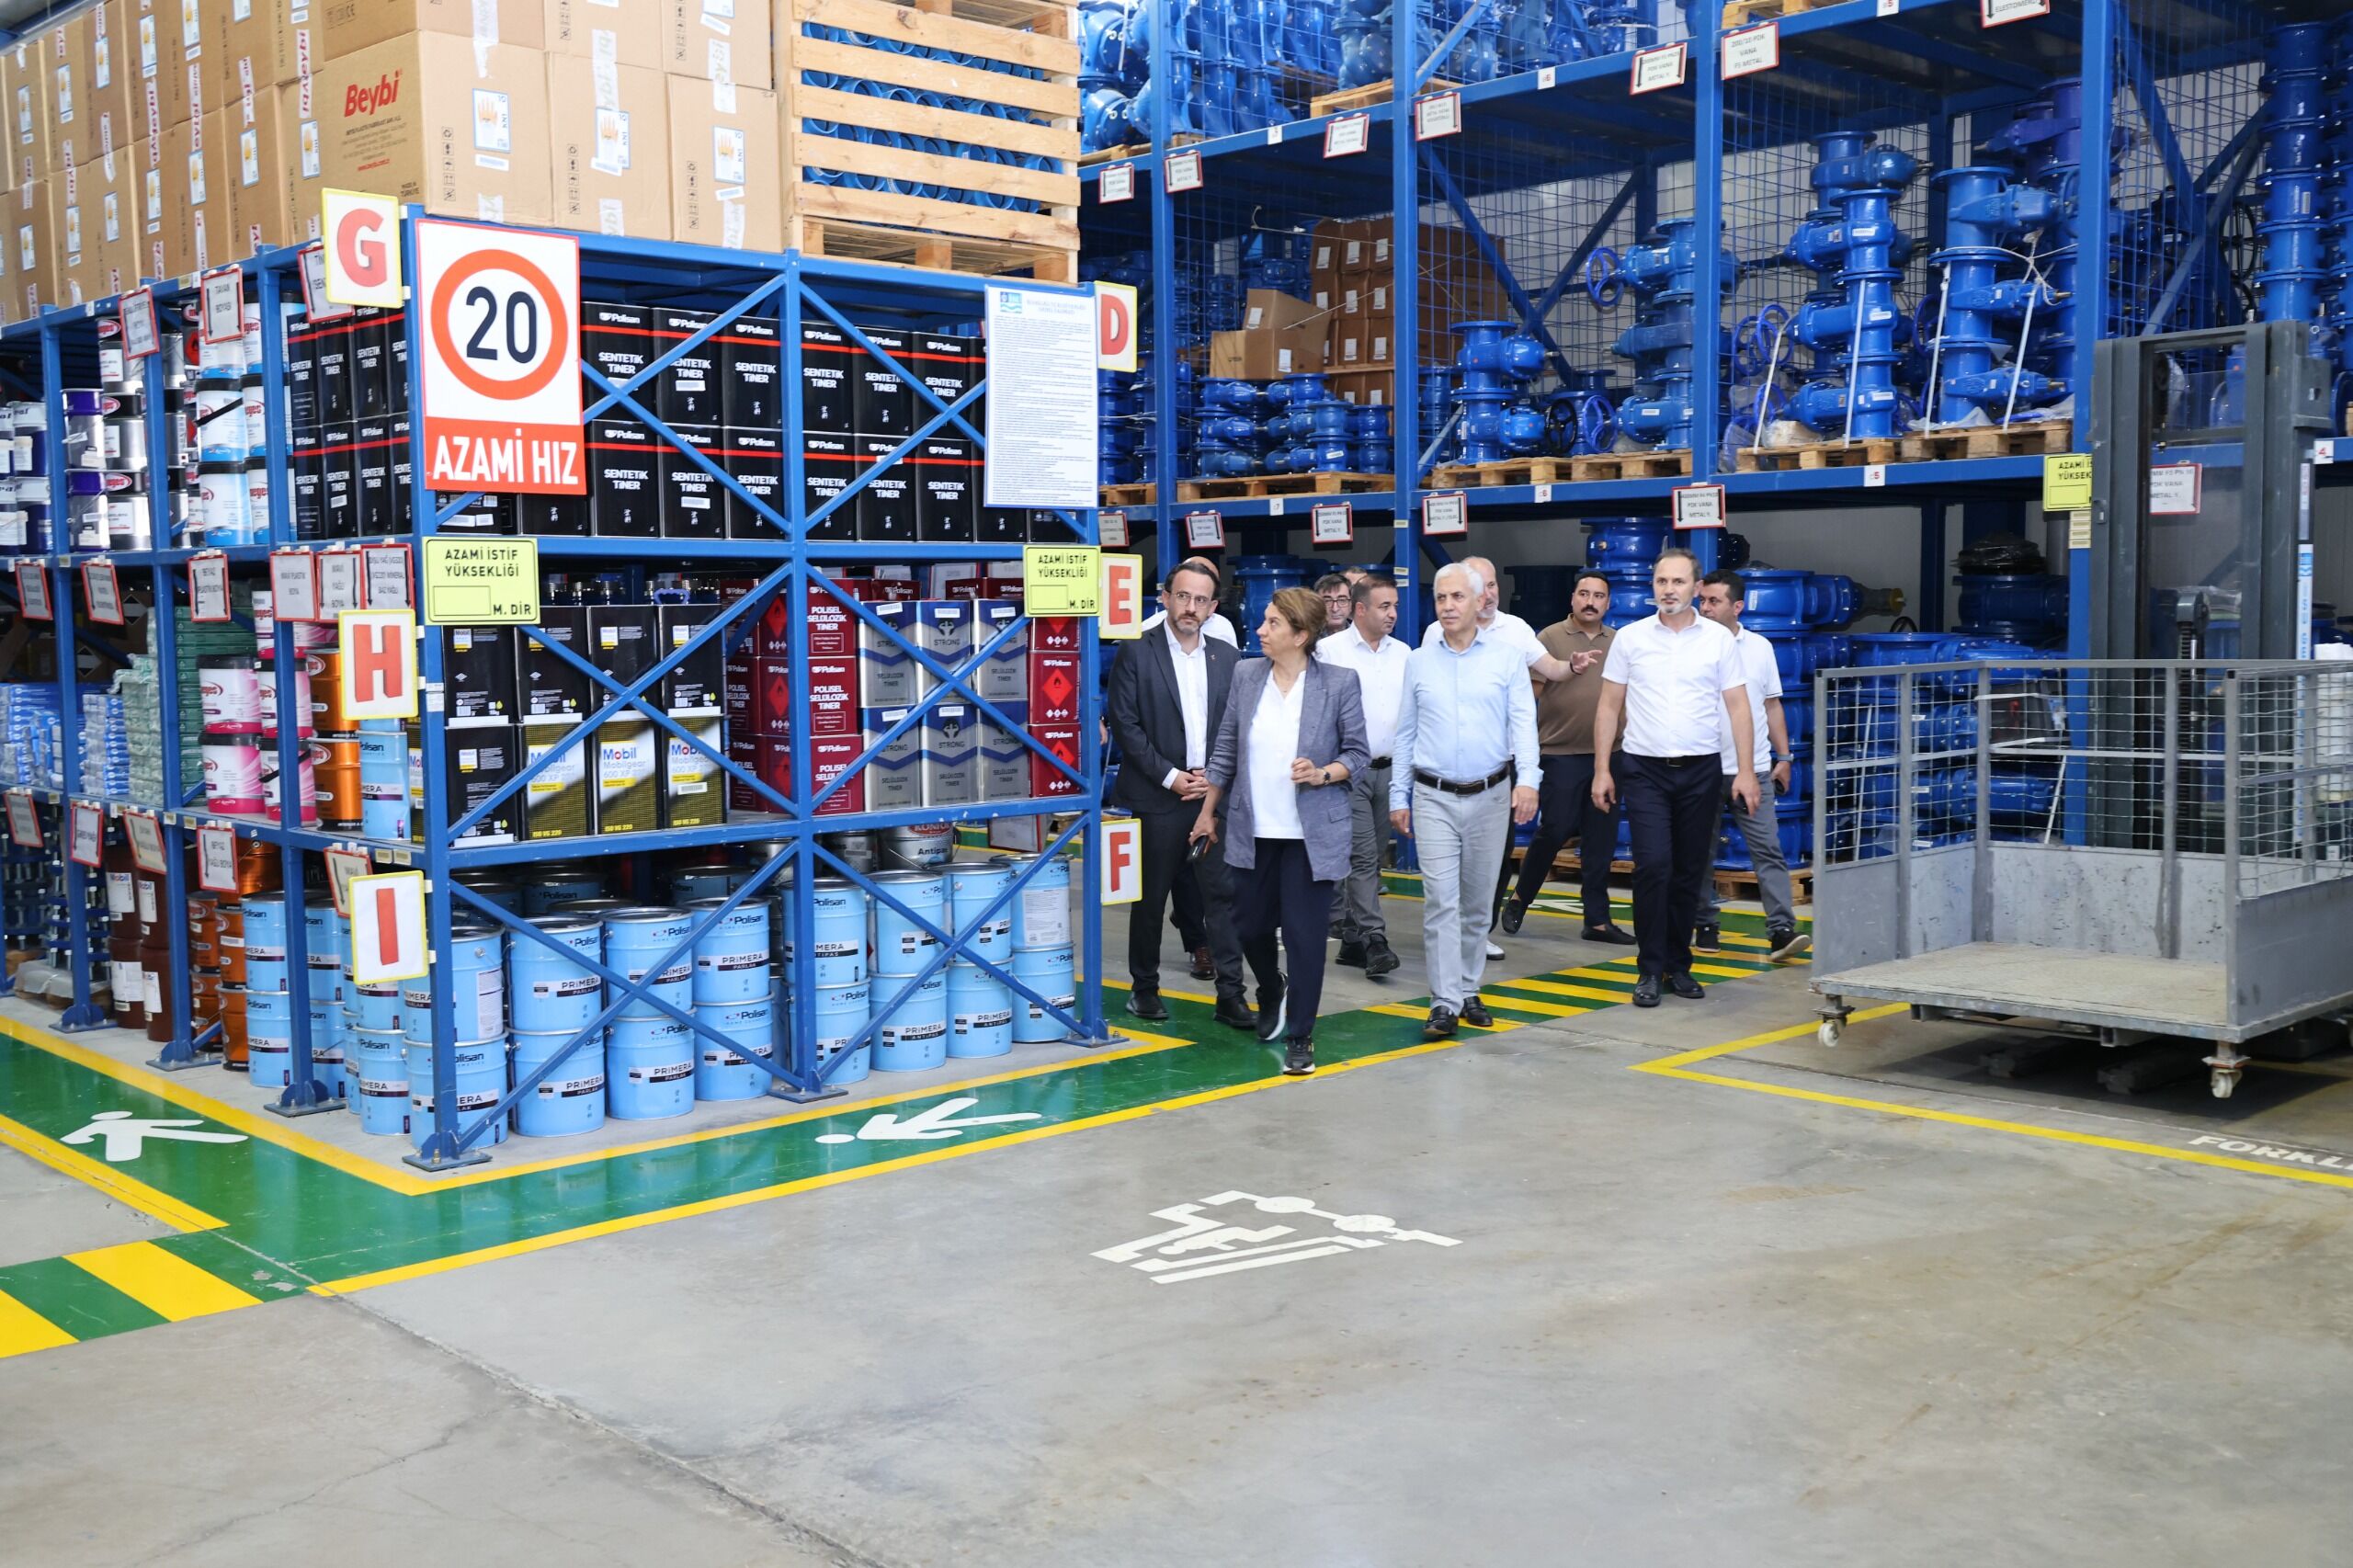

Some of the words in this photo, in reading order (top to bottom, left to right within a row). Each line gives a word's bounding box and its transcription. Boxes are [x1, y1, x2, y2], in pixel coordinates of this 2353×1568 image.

[345, 70, 399, 117] Beybi
[337, 209, 388, 287] G
[466, 286, 537, 364] 20
[1101, 294, 1129, 355] D
[433, 427, 524, 483] AZAMİ
[532, 439, 578, 484] HIZ
[2058, 469, 2093, 481] YÜKSEK
[446, 547, 483, 560] AZAMİ
[488, 547, 517, 560] İSTİF
[1039, 553, 1063, 563] AZAMİ
[1066, 553, 1087, 563] İSTİF
[446, 563, 518, 576] YÜKSEKLİĞİ
[1039, 566, 1087, 577] YÜKSEKLİĞİ
[494, 604, 506, 615] M.
[511, 601, 531, 615] DİR
[1081, 597, 1095, 608] DİR
[1109, 565, 1131, 625] E
[354, 624, 403, 702] H
[603, 747, 637, 760] Mobil
[938, 740, 964, 749] STRONG
[1110, 832, 1131, 892] F
[376, 888, 399, 965] I
